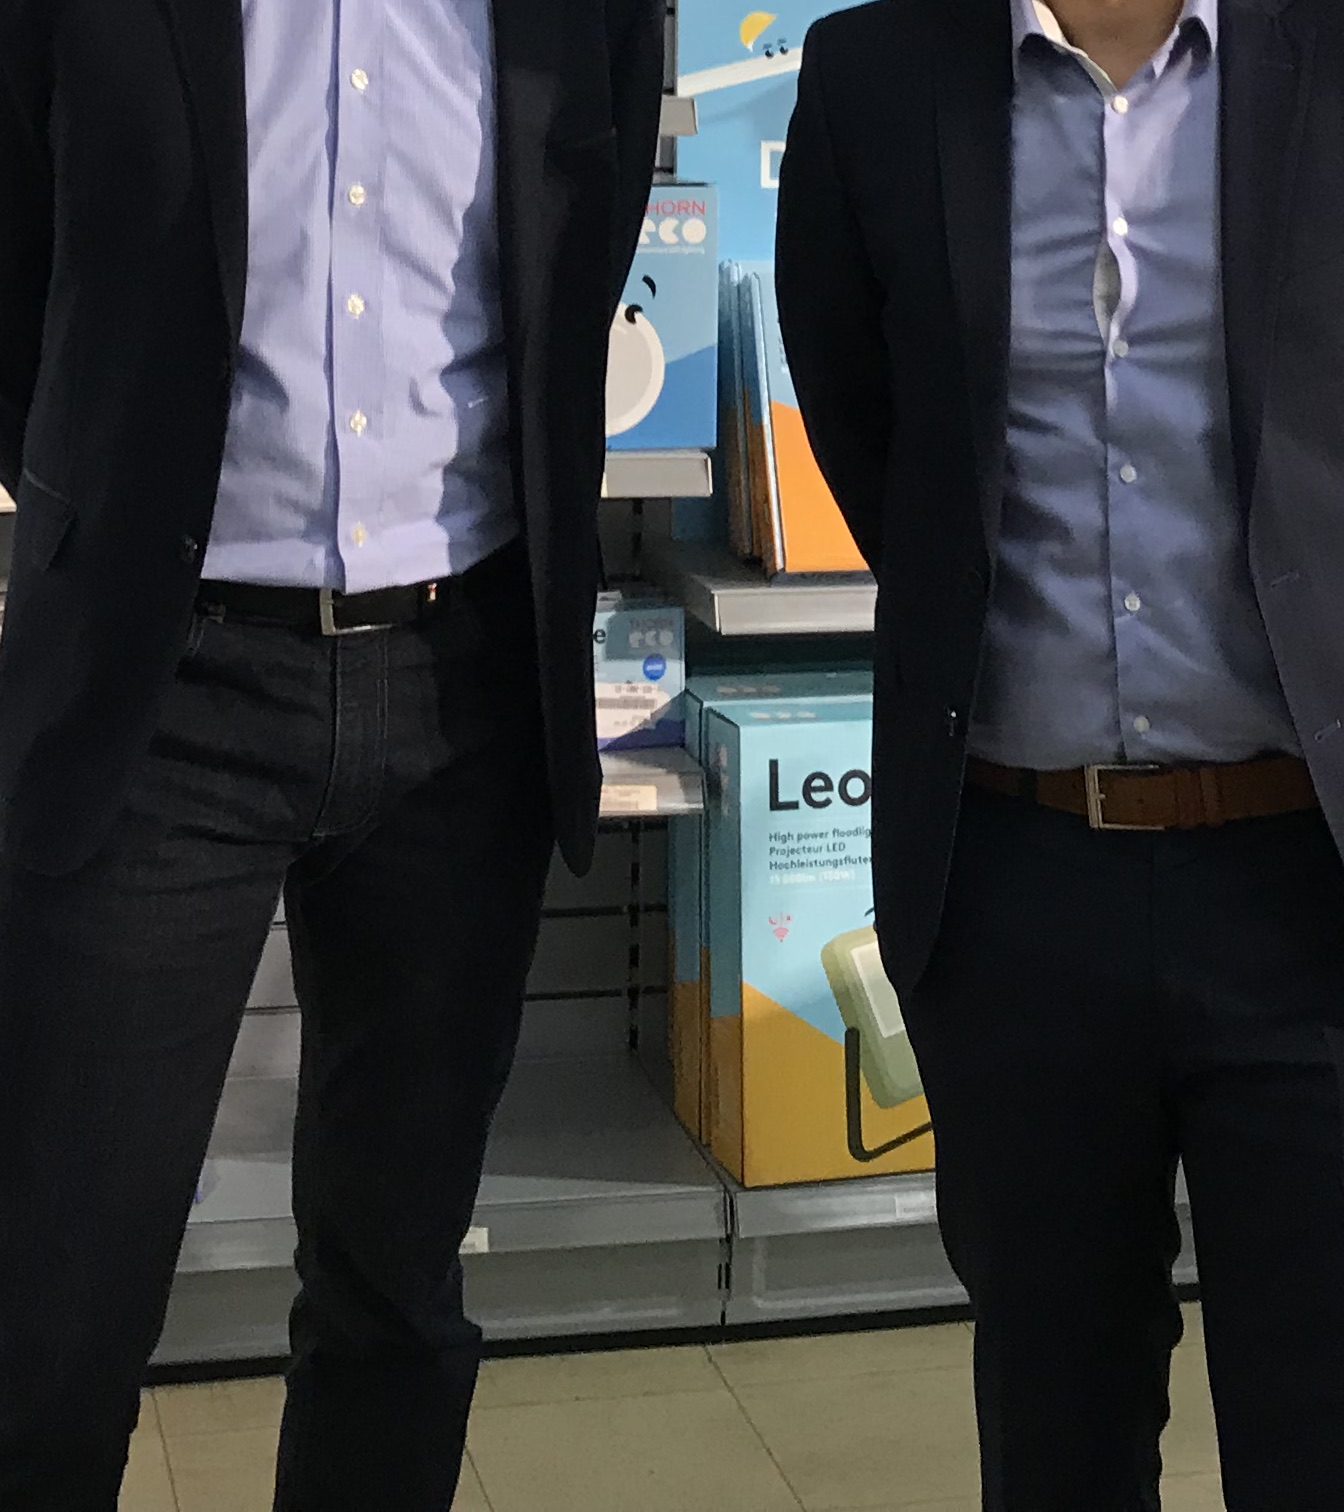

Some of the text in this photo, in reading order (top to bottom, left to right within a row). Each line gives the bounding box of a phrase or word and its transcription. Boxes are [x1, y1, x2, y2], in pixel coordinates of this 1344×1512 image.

[645, 199, 706, 216] HORN
[768, 758, 872, 811] Leo
[768, 826, 872, 844] High power floodlig
[769, 842, 846, 858] Projecteur LED
